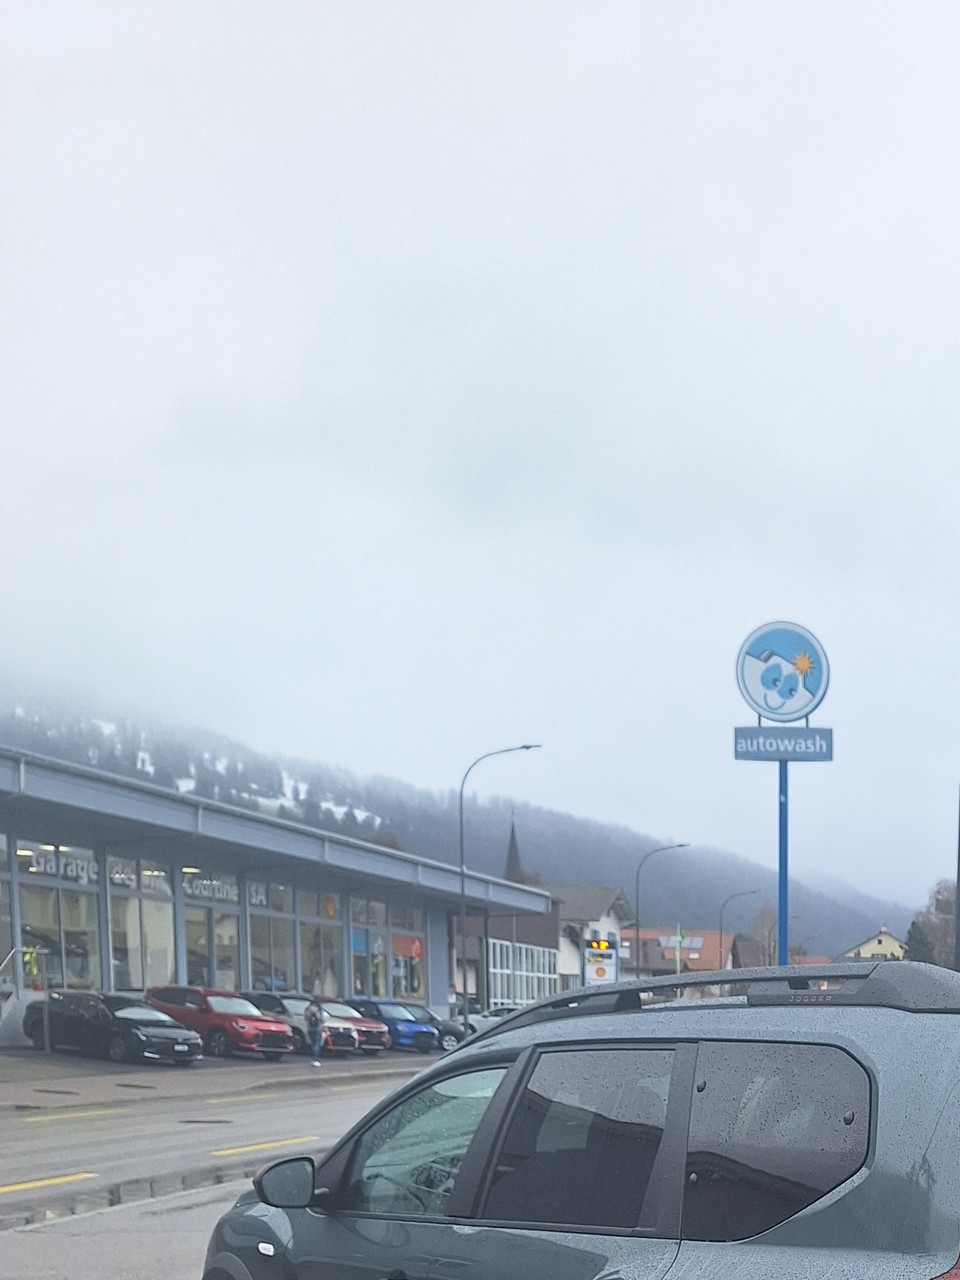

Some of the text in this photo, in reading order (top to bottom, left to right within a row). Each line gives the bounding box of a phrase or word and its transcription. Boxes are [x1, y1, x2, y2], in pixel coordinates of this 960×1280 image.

[736, 735, 827, 753] autowash
[32, 853, 98, 885] Garage
[250, 884, 267, 906] SA
